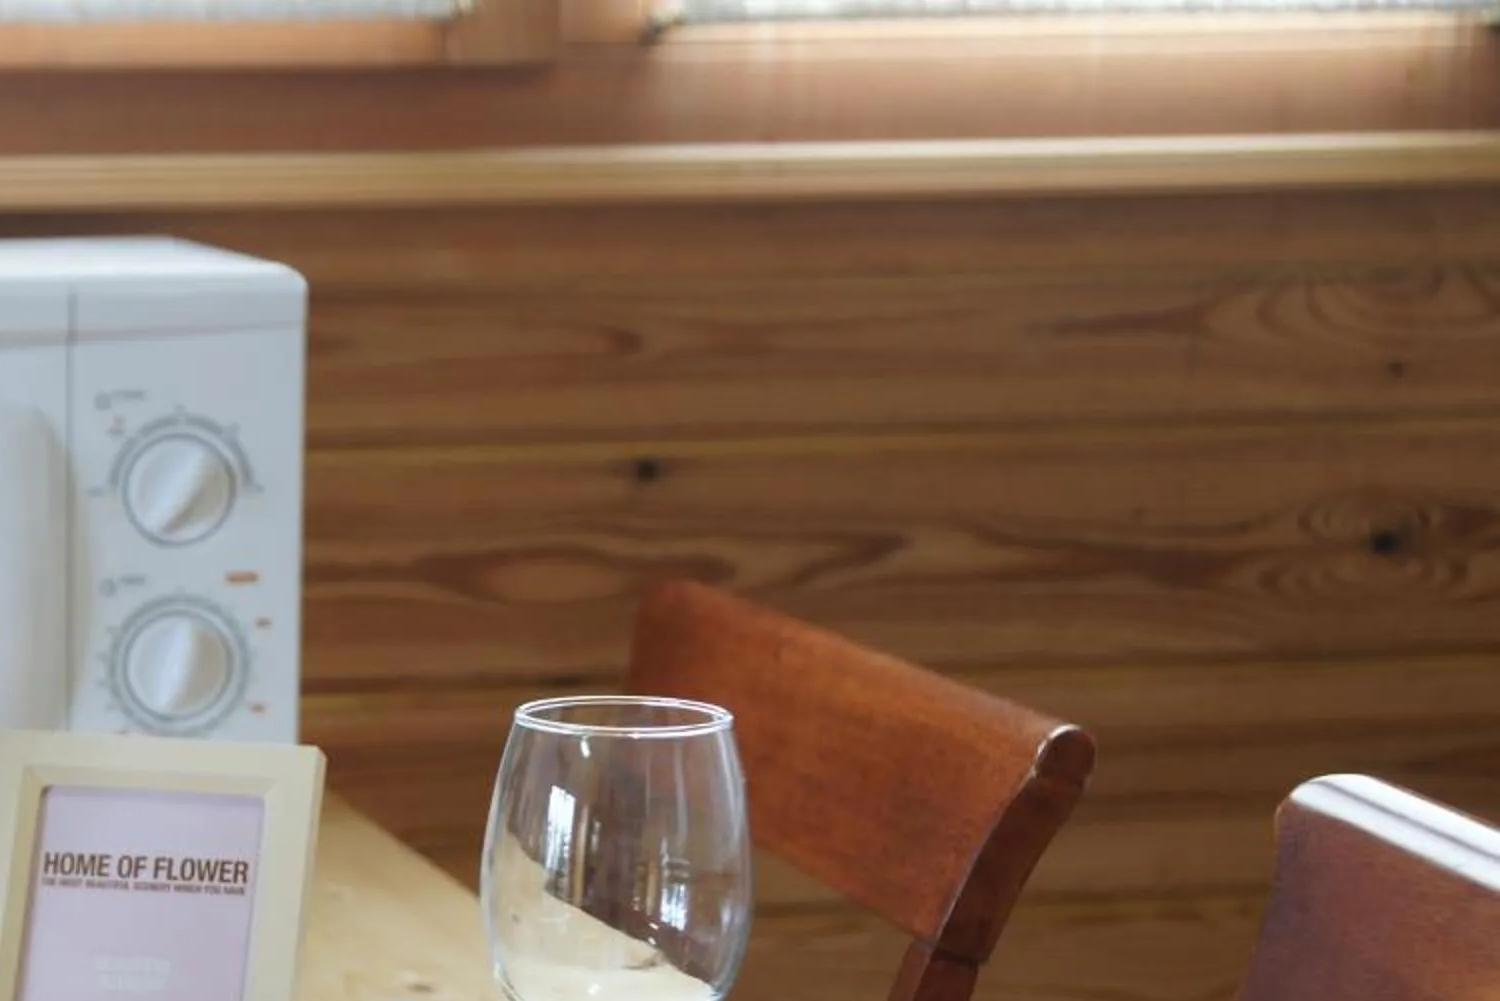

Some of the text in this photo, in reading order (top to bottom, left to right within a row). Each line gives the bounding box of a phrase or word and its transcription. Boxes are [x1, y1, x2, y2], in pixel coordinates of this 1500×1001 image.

[43, 851, 249, 885] HOME OF FLOWER
